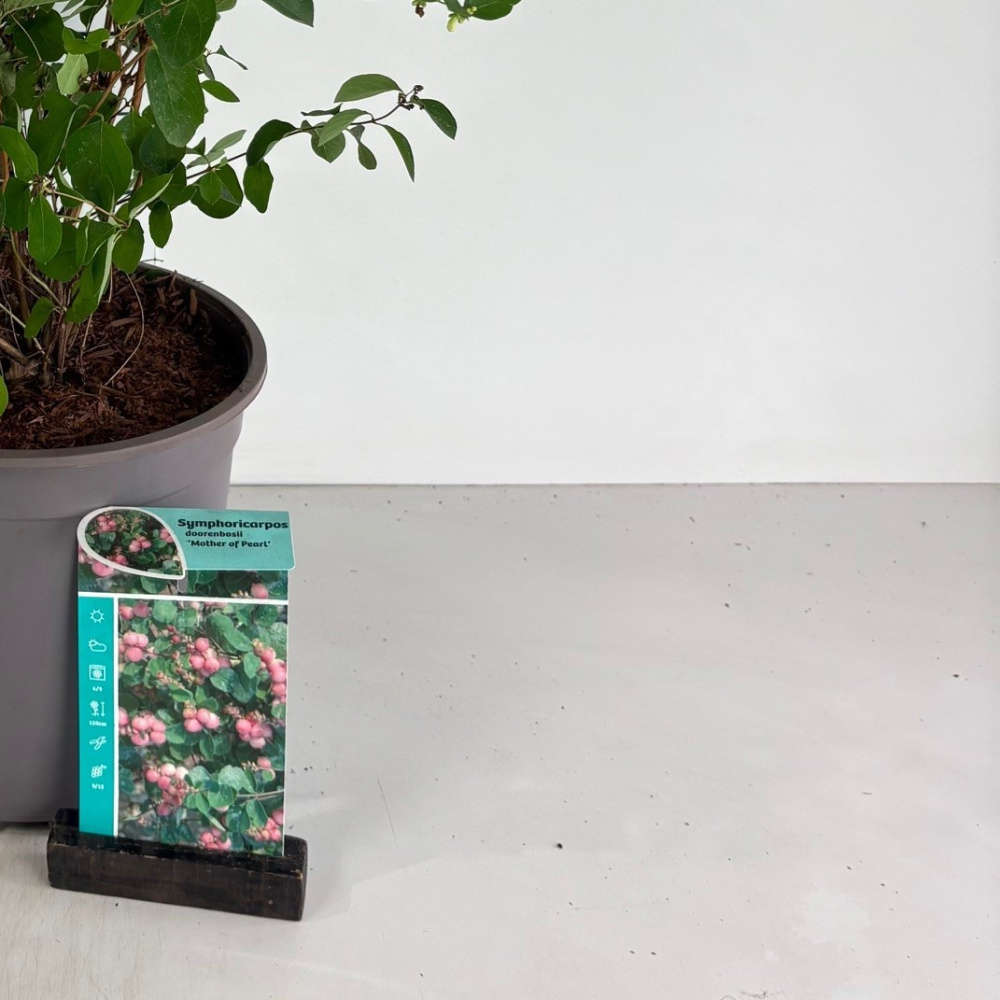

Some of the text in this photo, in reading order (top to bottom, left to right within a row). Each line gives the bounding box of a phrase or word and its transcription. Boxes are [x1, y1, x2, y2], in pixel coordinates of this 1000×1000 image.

[178, 518, 289, 531] Symphoricarpos
[185, 530, 243, 538] doorenbosii
[187, 540, 271, 549] 'Mother of Pearl'
